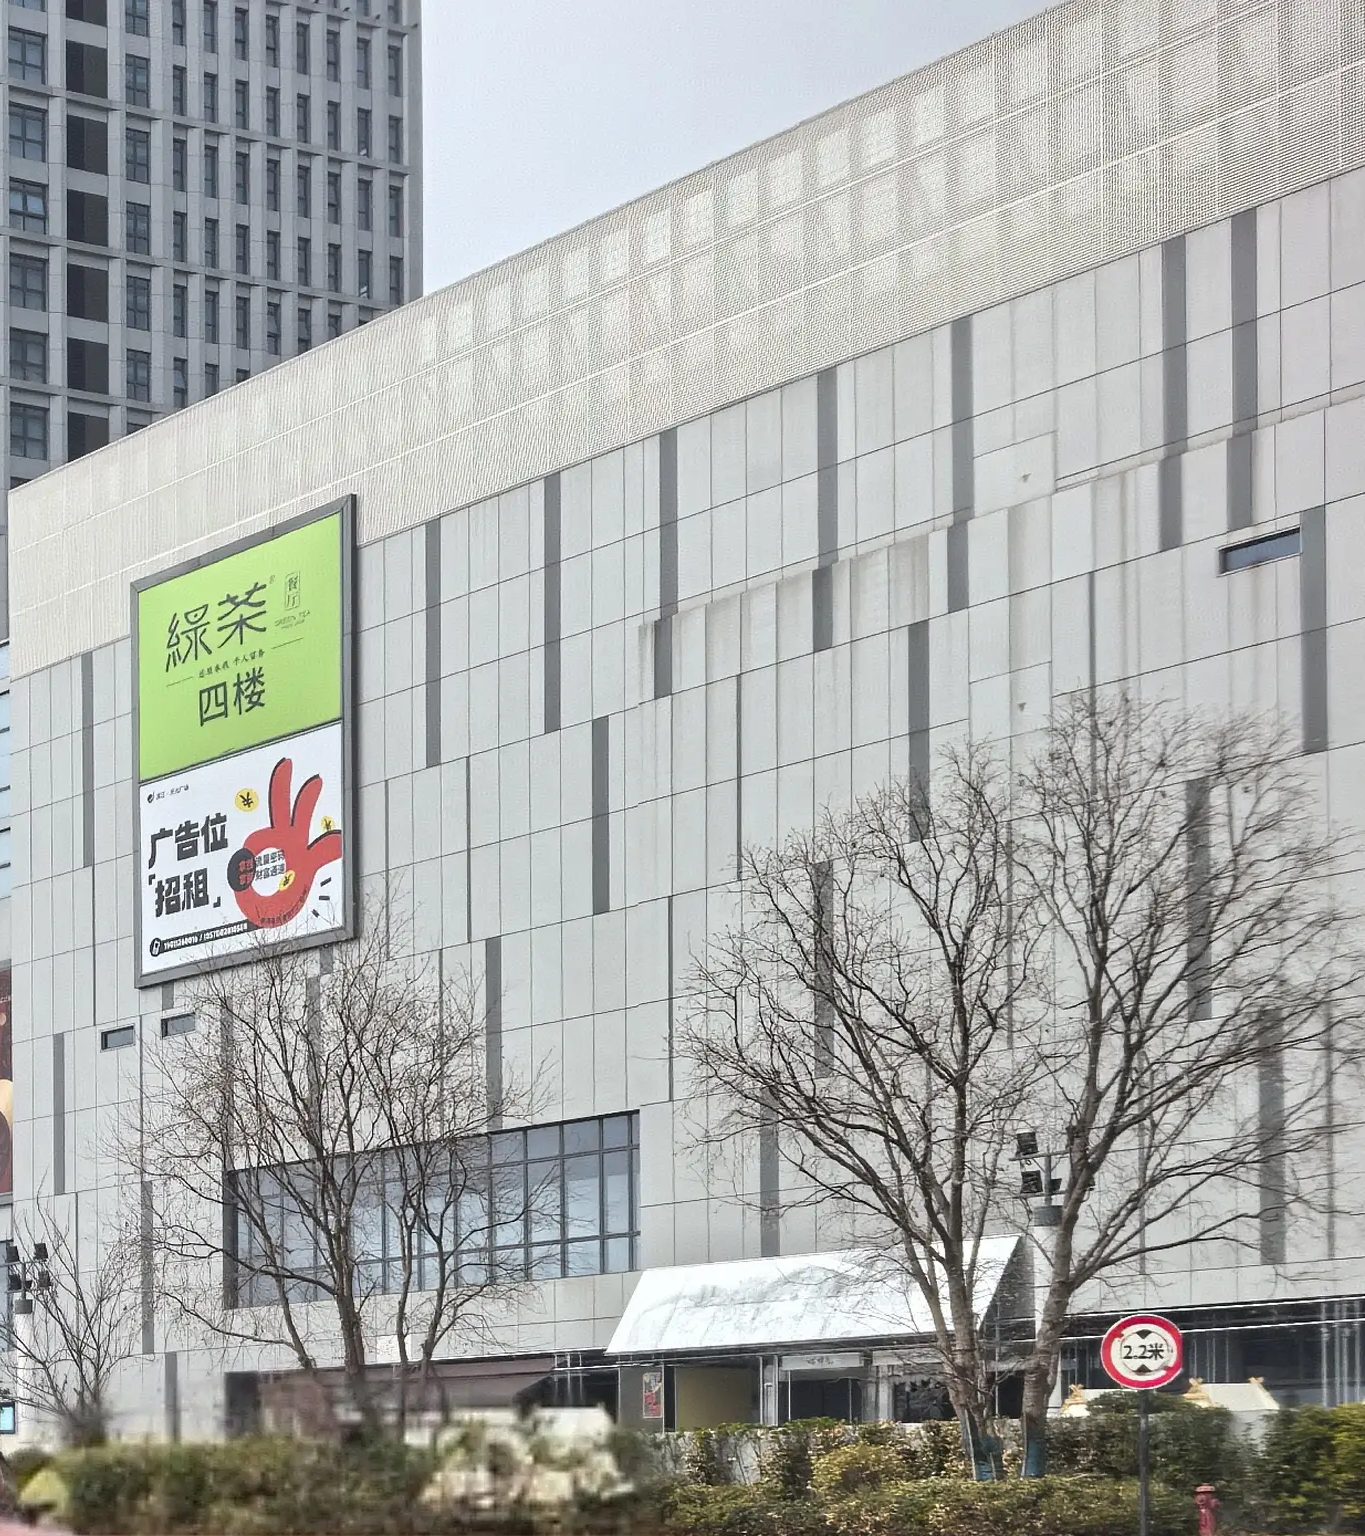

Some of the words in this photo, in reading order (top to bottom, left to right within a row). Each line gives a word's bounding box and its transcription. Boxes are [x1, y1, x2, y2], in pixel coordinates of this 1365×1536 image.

[199, 666, 266, 727] 四楼
[148, 812, 228, 870] 广告位
[1123, 1342, 1165, 1361] 2.2米
